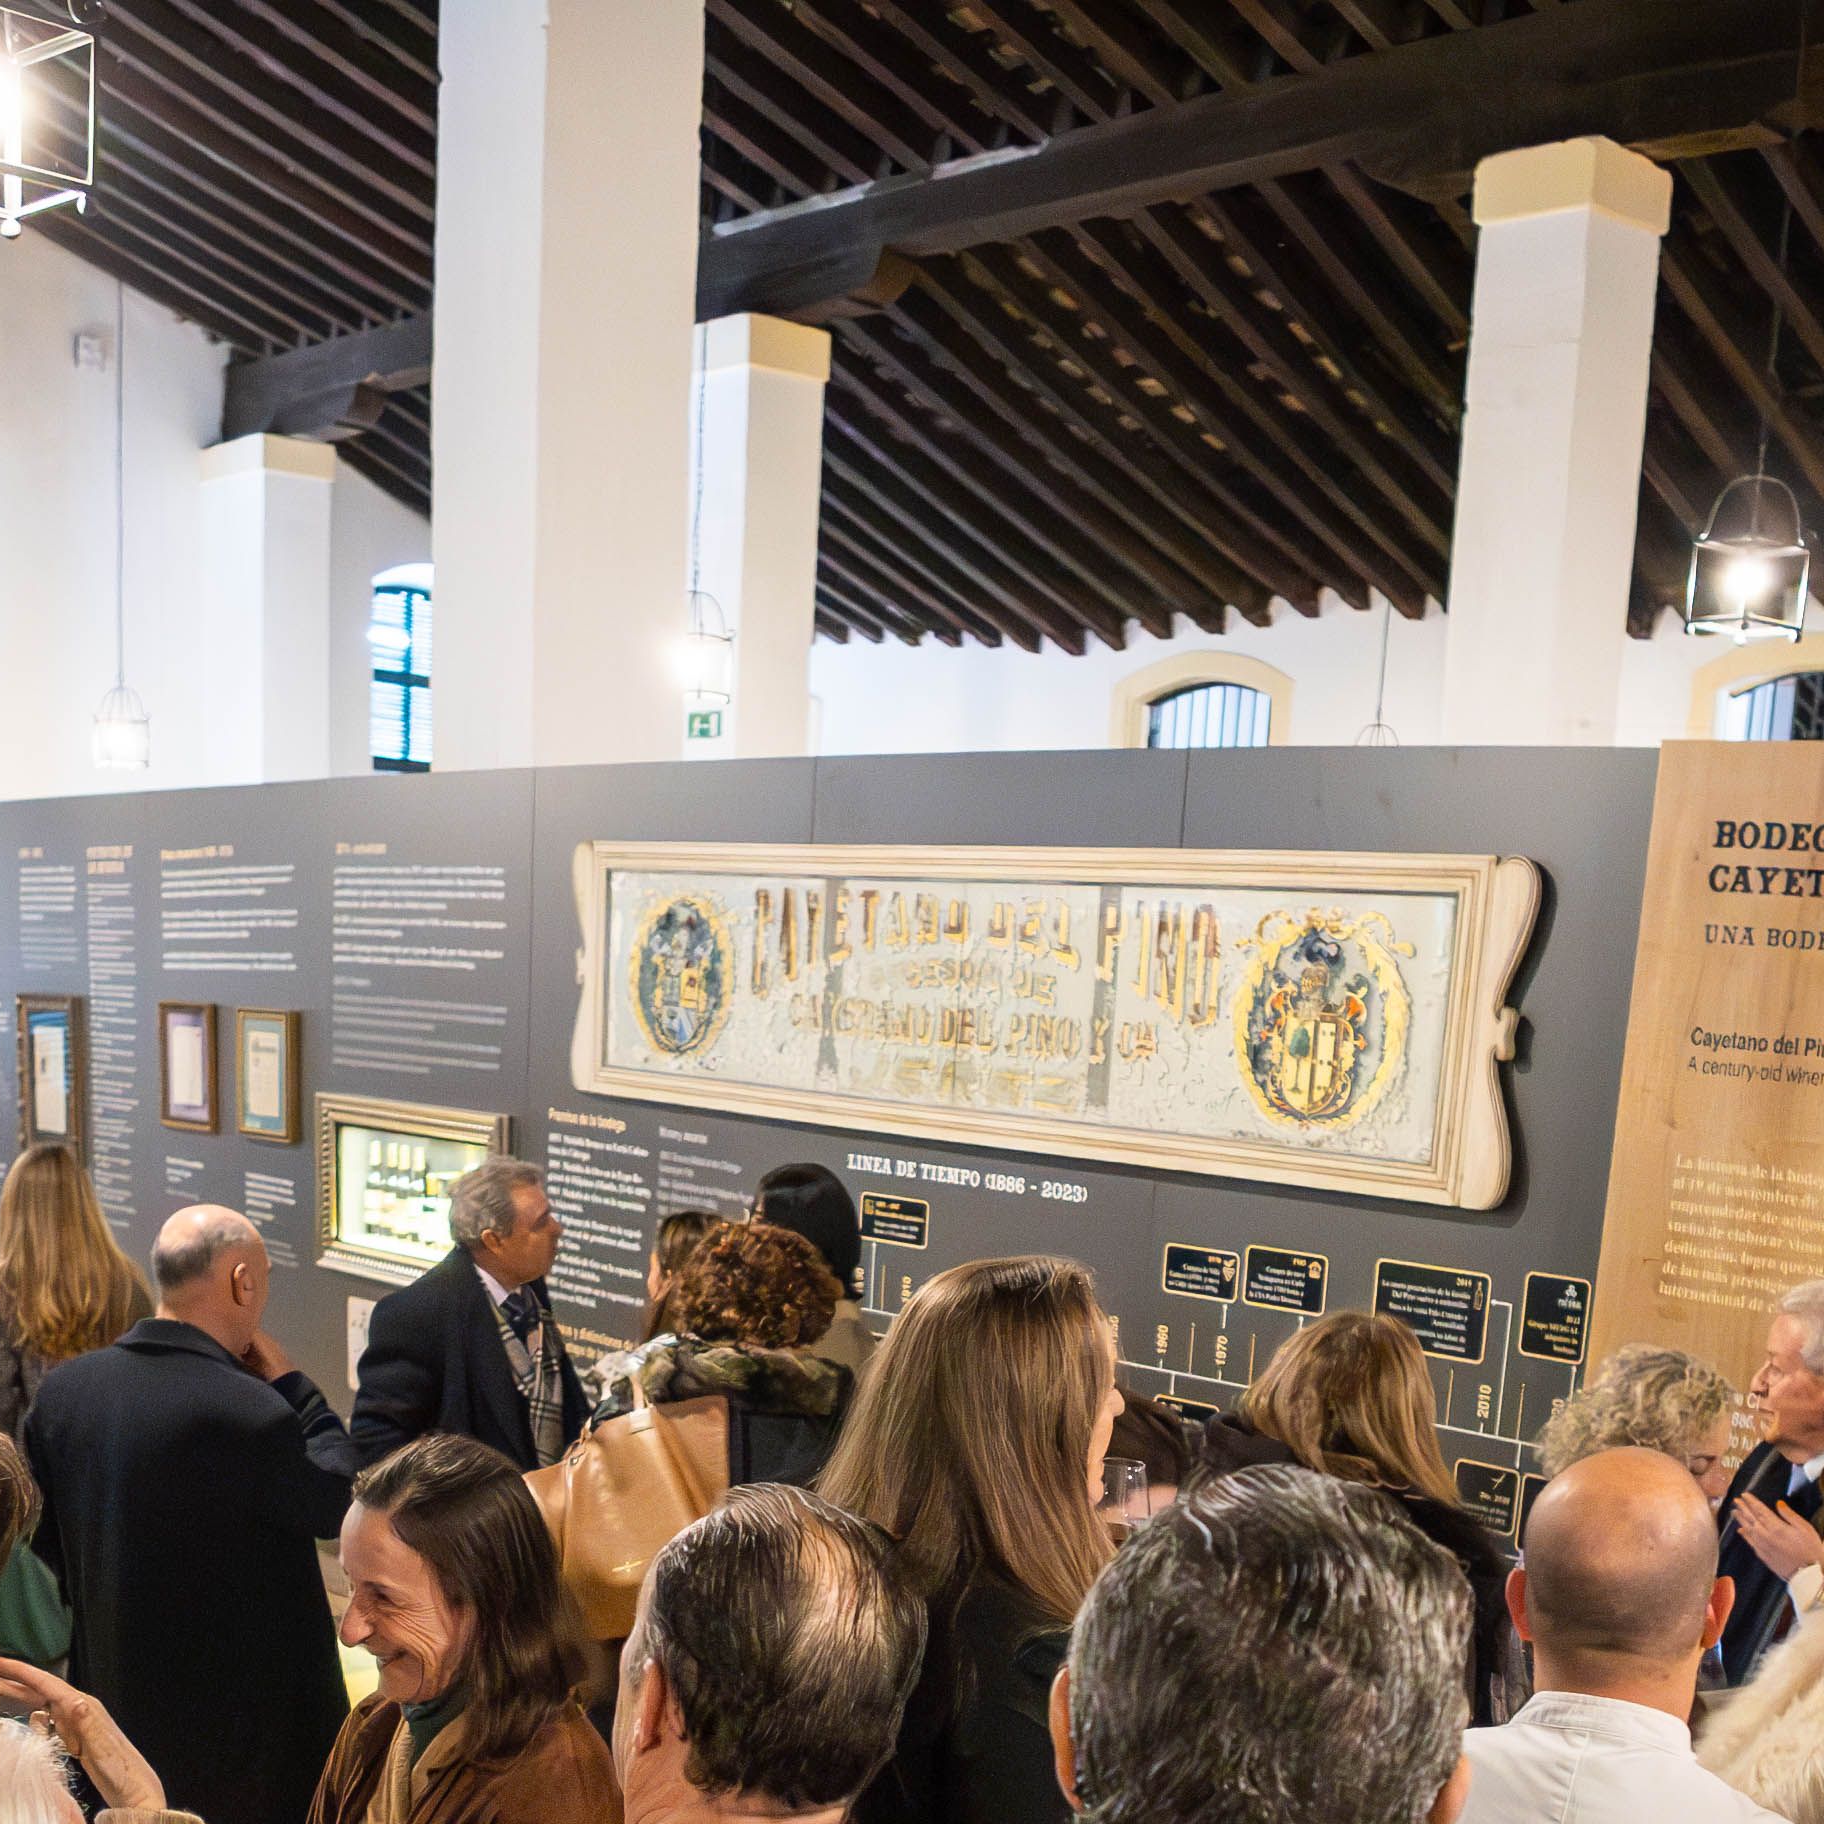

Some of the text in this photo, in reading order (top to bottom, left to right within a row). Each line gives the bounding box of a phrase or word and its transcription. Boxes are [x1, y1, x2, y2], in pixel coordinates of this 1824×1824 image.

[1704, 923, 1755, 947] UNA
[1690, 1026, 1768, 1053] Cayetano
[1772, 1034, 1799, 1056] del
[1688, 1056, 1697, 1072] A
[1702, 1058, 1783, 1083] century-old
[1677, 1154, 1693, 1169] La
[846, 1153, 893, 1176] LINEA
[896, 1160, 918, 1179] DE
[920, 1163, 981, 1188] TIEMPO
[985, 1172, 1026, 1195] (1886
[1040, 1181, 1088, 1203] 2023)
[1215, 1335, 1228, 1366] 1970
[1477, 1384, 1492, 1420] 2010
